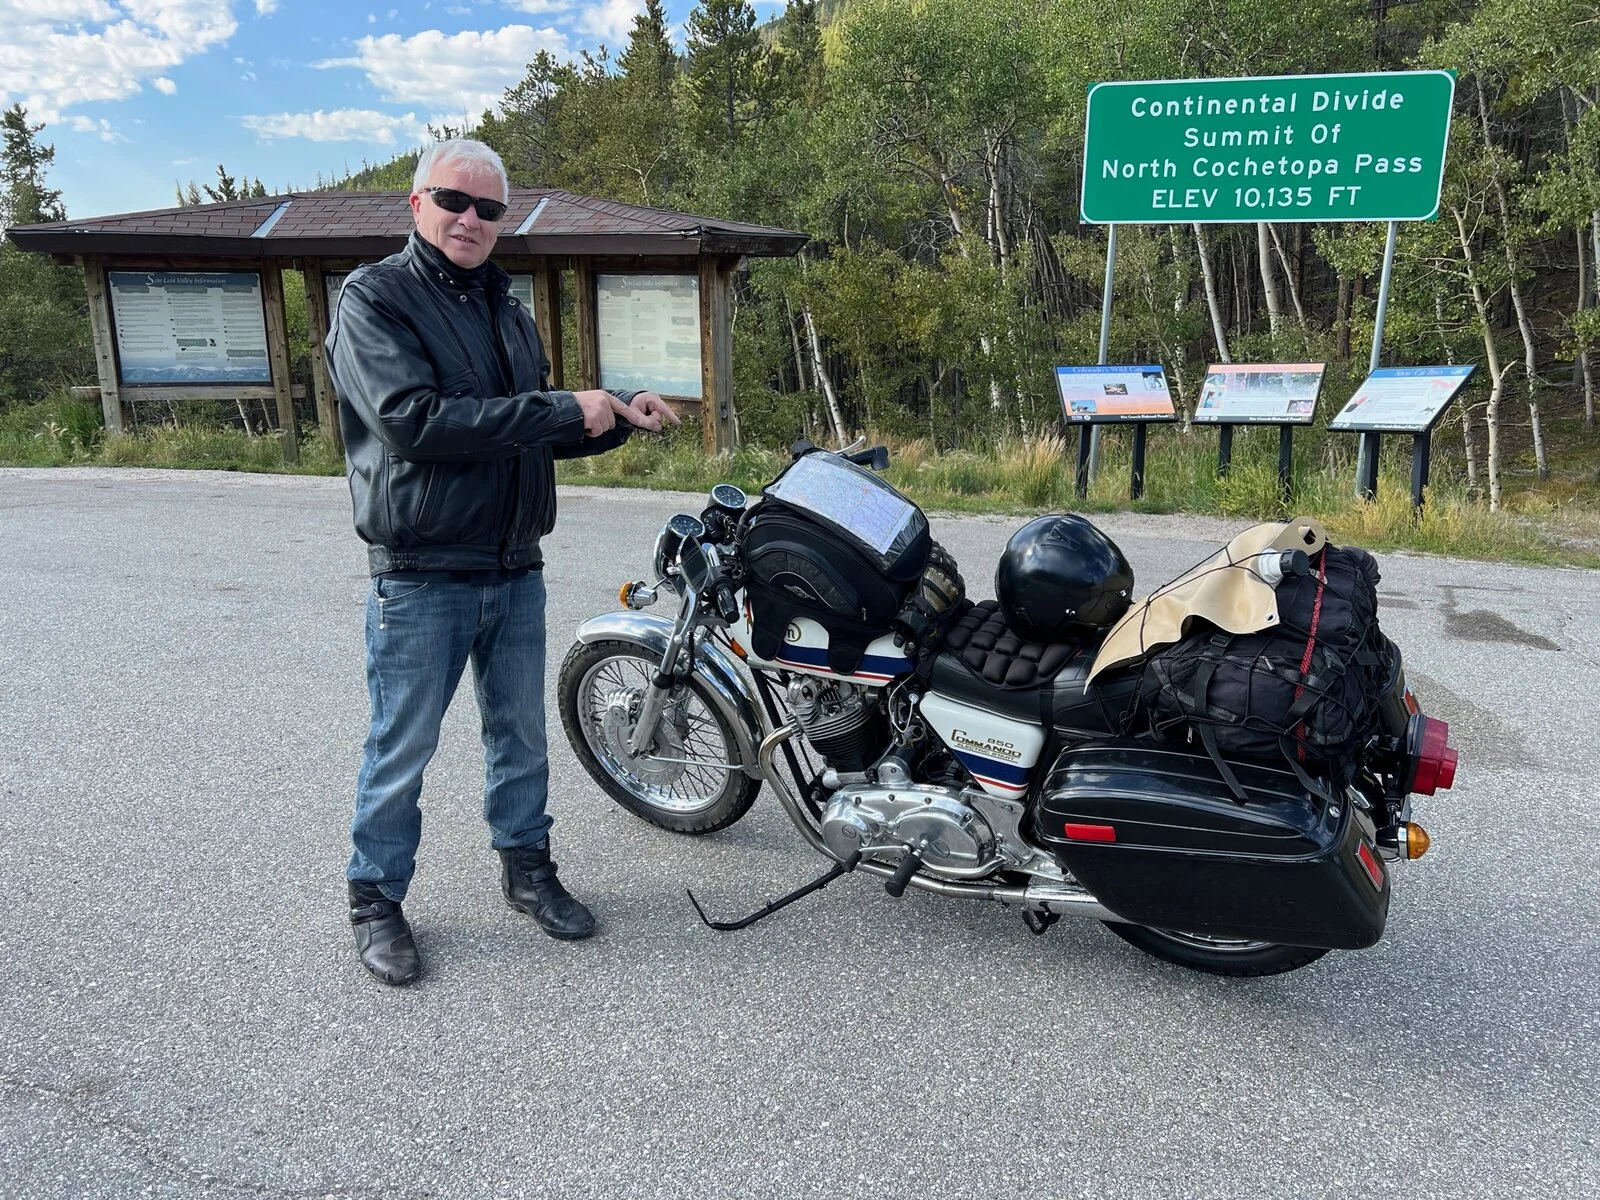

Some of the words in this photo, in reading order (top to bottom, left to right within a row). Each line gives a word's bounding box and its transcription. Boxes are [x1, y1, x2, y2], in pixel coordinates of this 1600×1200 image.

[1130, 92, 1297, 118] Continental
[1311, 89, 1405, 112] Divide
[1183, 124, 1294, 148] Summit
[1310, 123, 1342, 144] Of
[1102, 159, 1177, 179] North
[1192, 155, 1340, 180] Cochetopa
[1354, 153, 1423, 174] Pass
[1152, 188, 1219, 209] ELEV
[1234, 187, 1313, 209] 10,135
[1328, 185, 1362, 206] FT
[146, 273, 162, 285] San
[177, 277, 193, 285] Valley
[957, 743, 988, 755] ELECTRIC
[992, 752, 1014, 761] START
[986, 737, 1014, 748] 850
